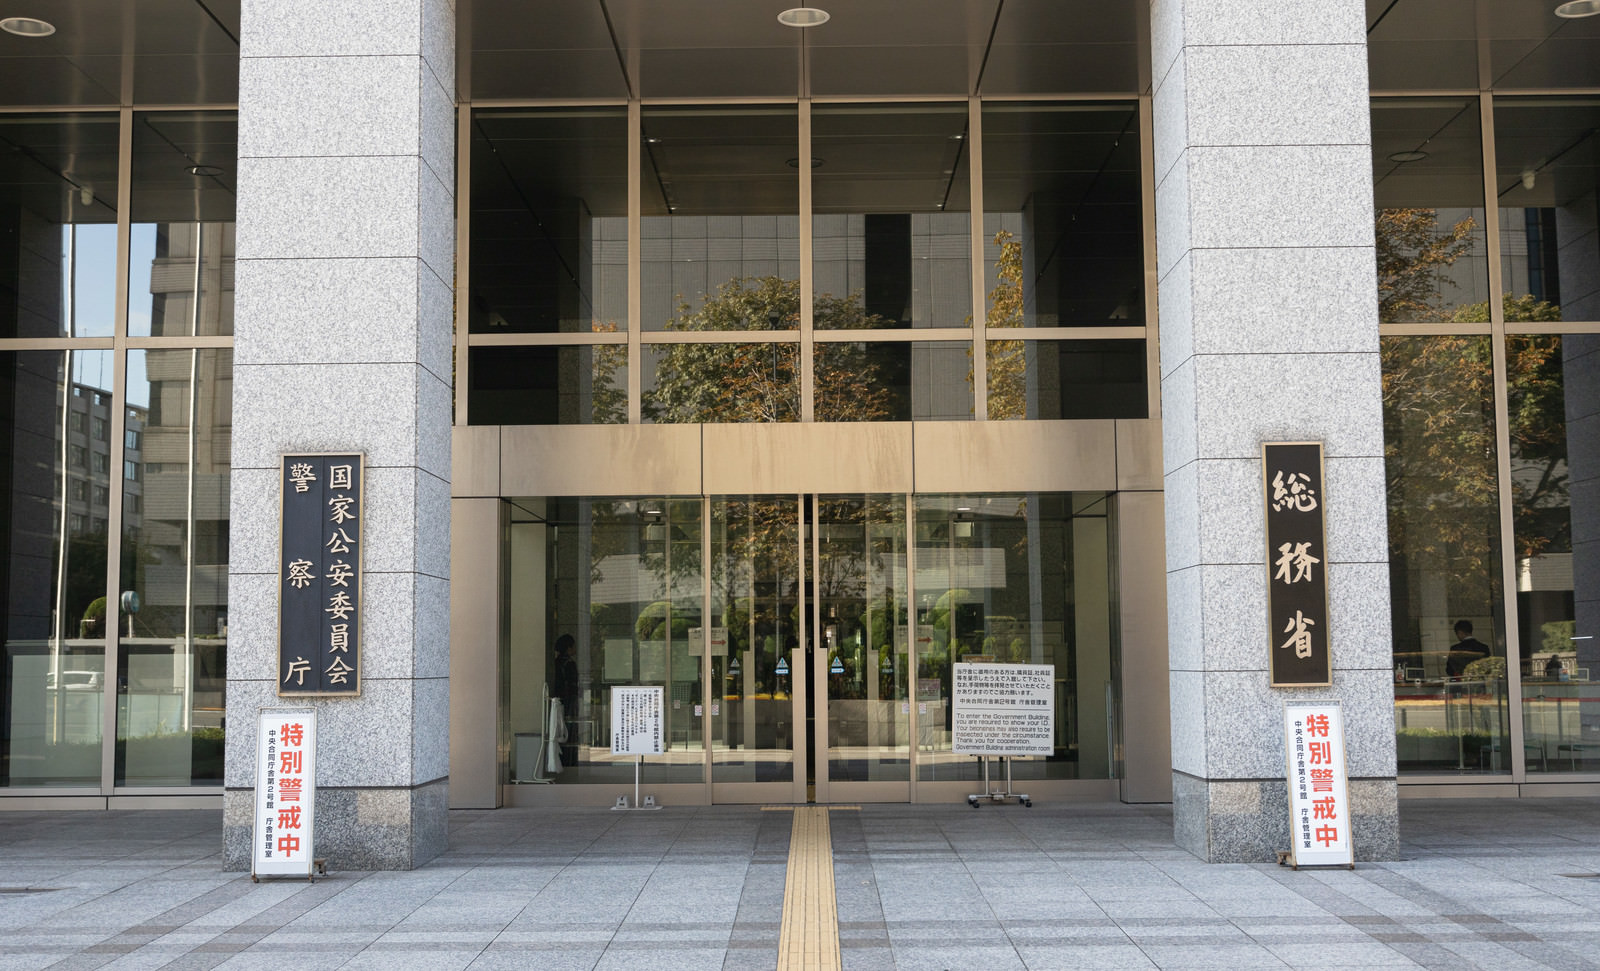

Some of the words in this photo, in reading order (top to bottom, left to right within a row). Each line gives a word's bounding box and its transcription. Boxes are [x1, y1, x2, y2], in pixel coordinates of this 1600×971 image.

[284, 463, 317, 686] 警察庁
[325, 464, 355, 686] 国家公安委員会
[1272, 470, 1320, 660] 総務省
[266, 729, 276, 809] 中央合同庁舎第2号館
[277, 722, 304, 858] 特別警戒中
[1294, 720, 1308, 800] 中央合同庁舎第2号館
[1301, 808, 1312, 849] 庁舎管理室
[1306, 713, 1338, 849] 特別警戒中
[264, 817, 274, 858] 庁舎管理室
